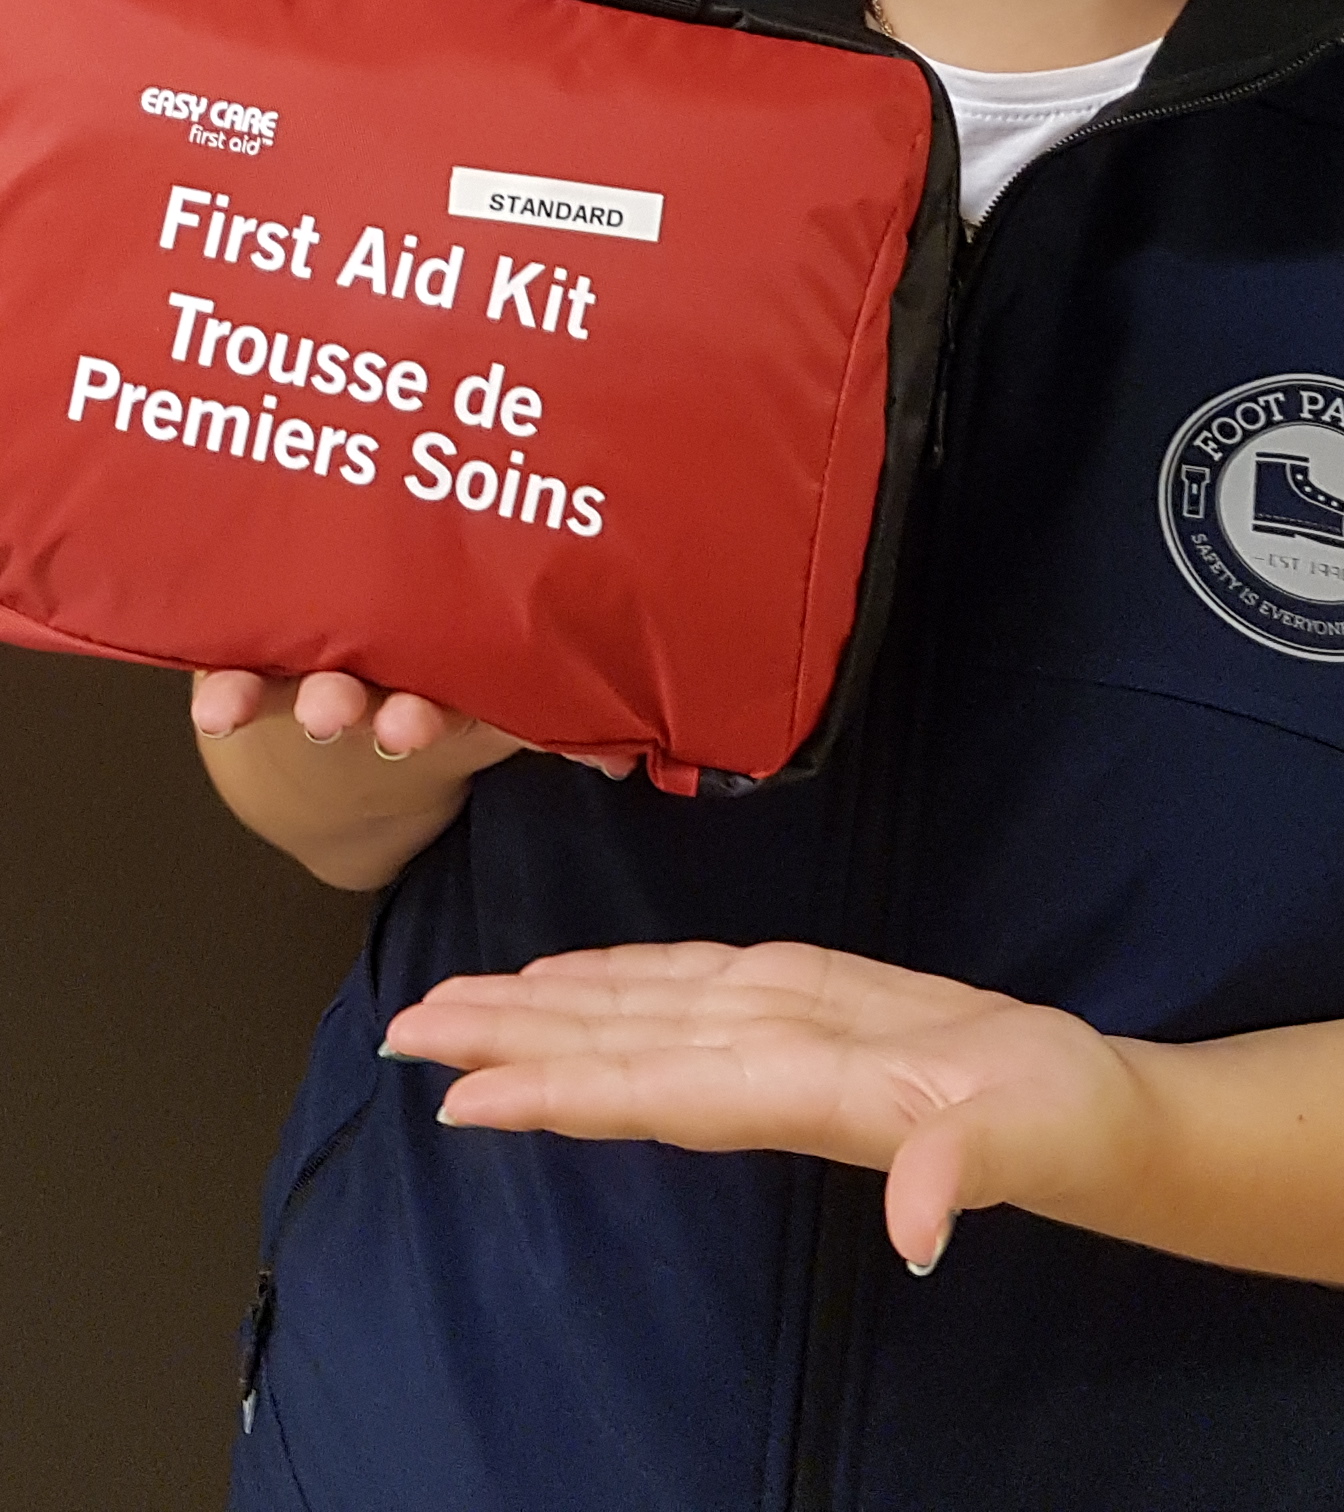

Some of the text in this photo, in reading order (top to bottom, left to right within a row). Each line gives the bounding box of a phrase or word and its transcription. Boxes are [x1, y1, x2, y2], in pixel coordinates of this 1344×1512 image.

[140, 86, 280, 138] EASY CARE
[189, 123, 227, 150] first
[488, 192, 625, 230] STANDARD
[158, 184, 596, 341] First Aid Kit
[167, 291, 544, 438] Trousse de
[66, 354, 606, 539] Premiers Soins
[1193, 391, 1286, 462] FOOT
[1190, 533, 1244, 591] SAFETY
[1238, 586, 1261, 607] IS
